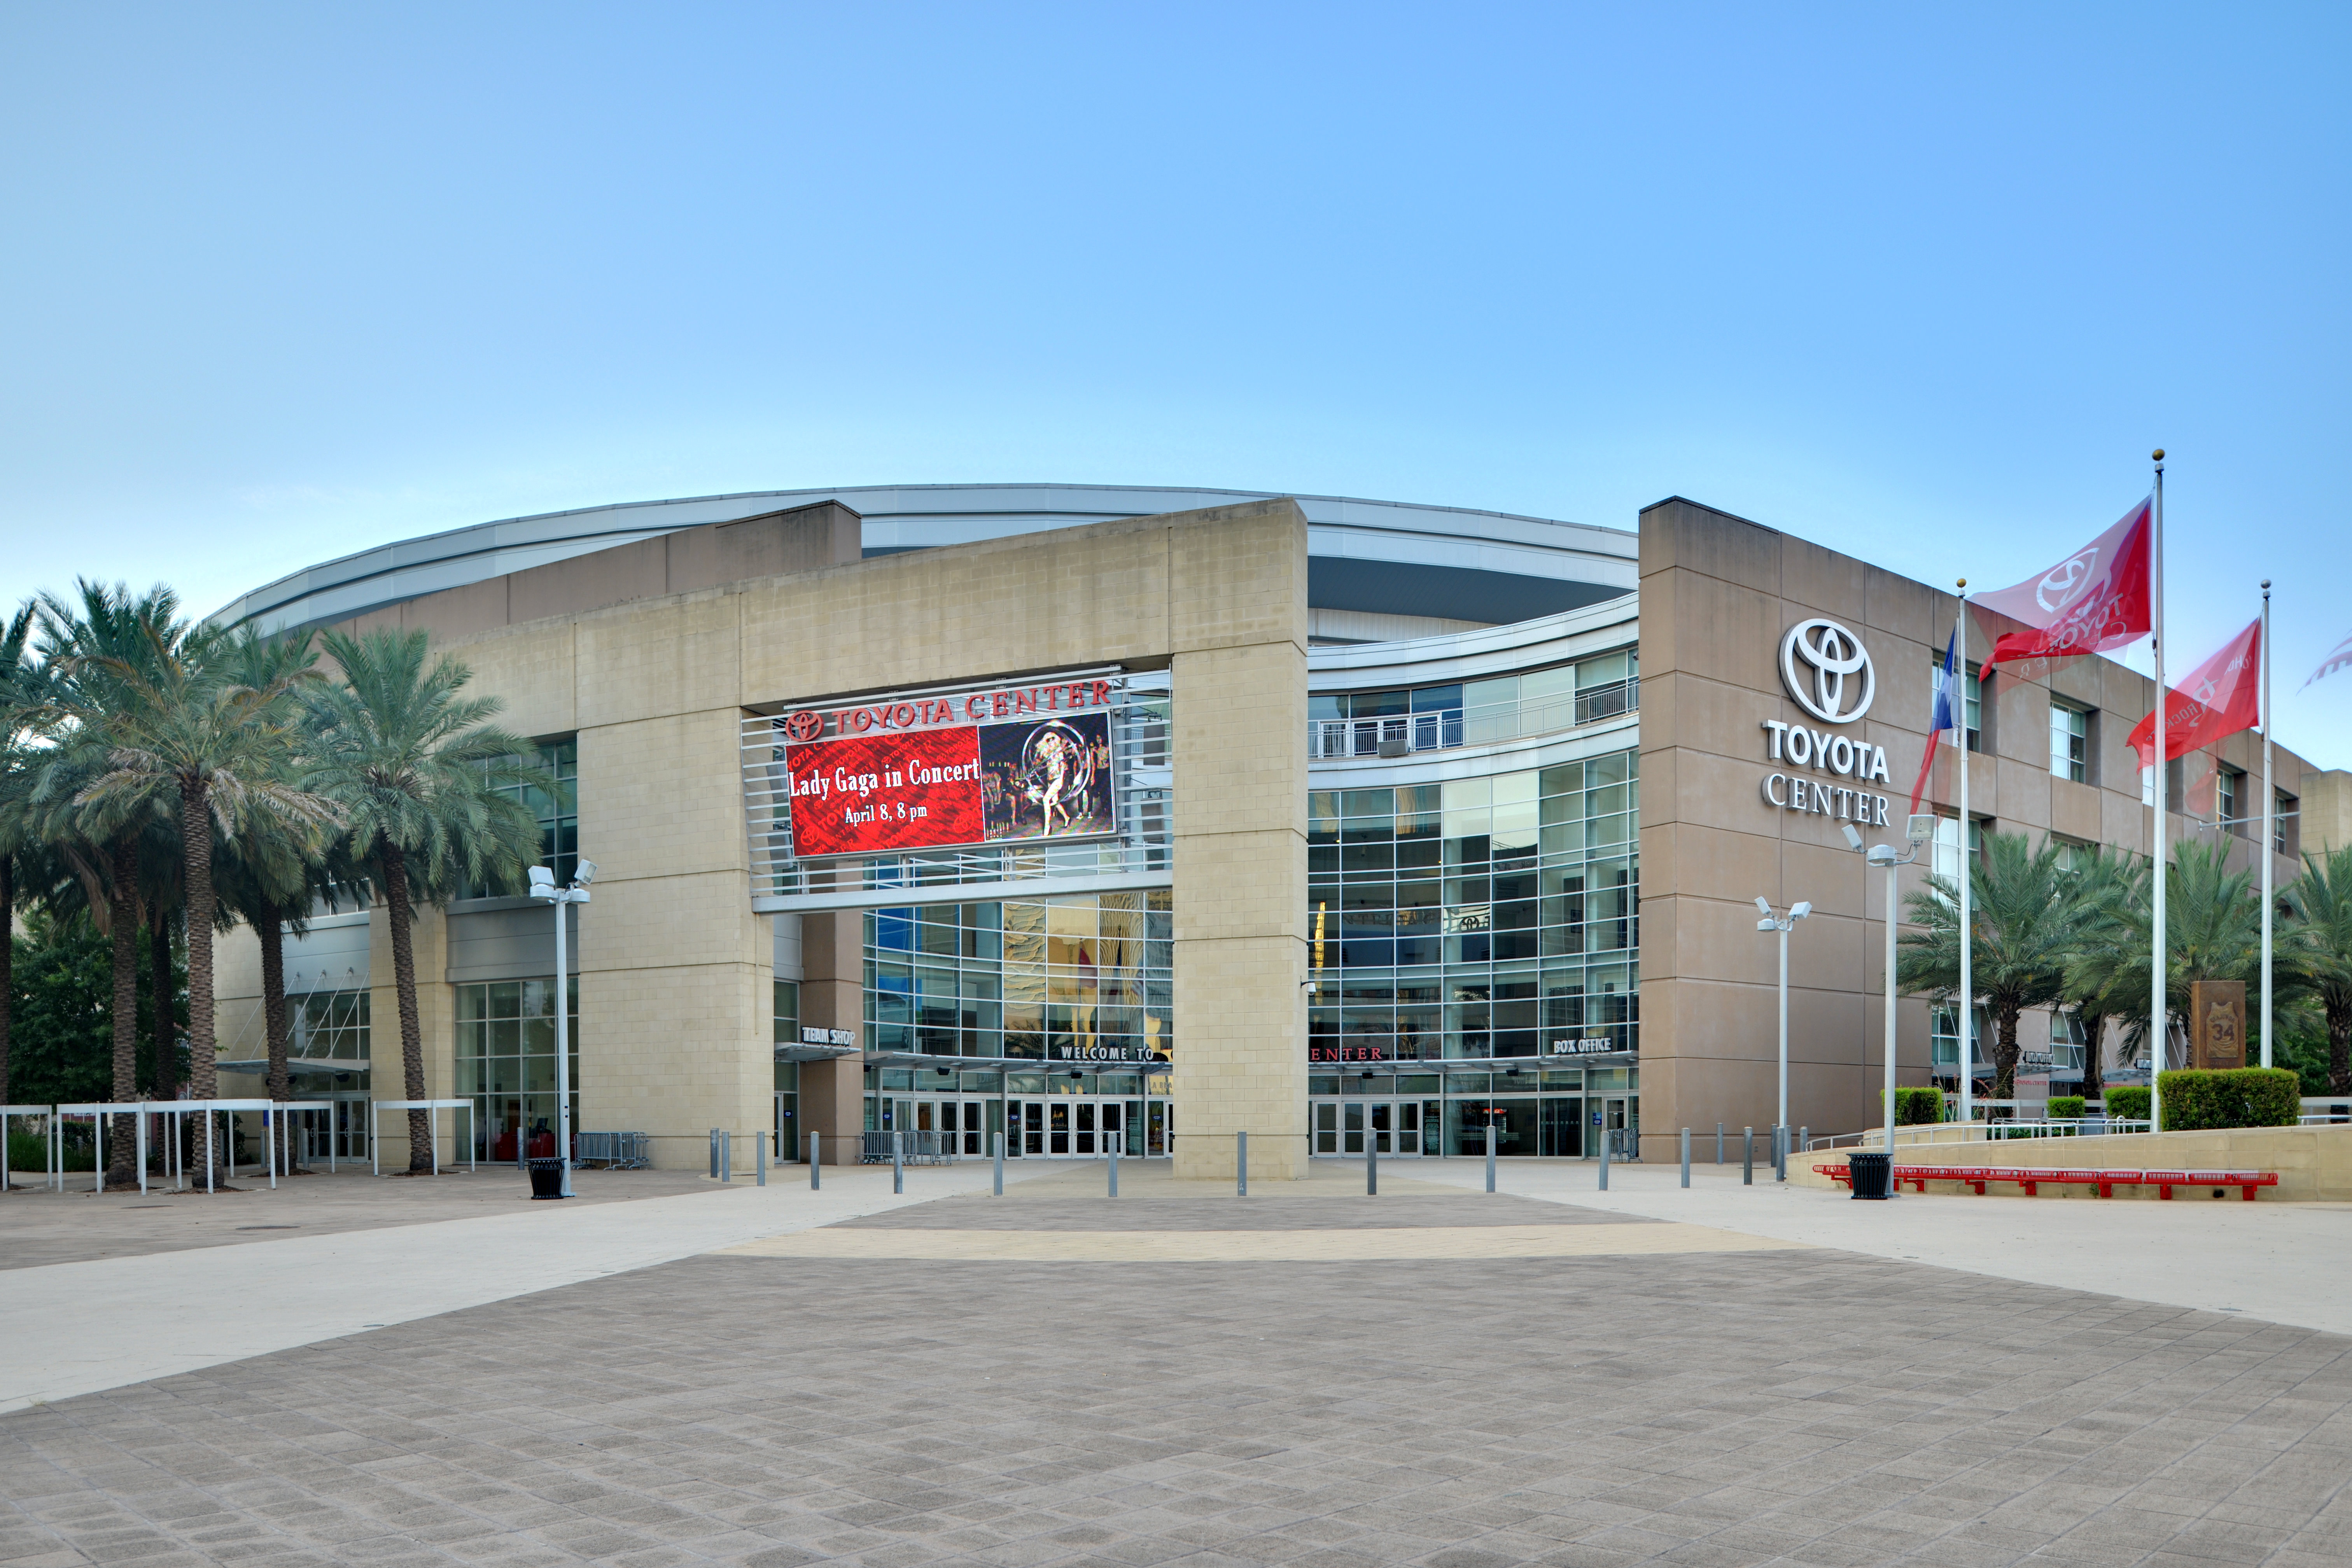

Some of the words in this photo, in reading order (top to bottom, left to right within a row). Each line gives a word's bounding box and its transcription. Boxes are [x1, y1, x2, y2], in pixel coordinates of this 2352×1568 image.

[832, 699, 954, 733] TOYOTA
[964, 680, 1111, 719] CENTER
[1762, 719, 1890, 784] TOYOTA
[789, 769, 830, 801] Lady
[835, 766, 879, 797] Gaga
[885, 764, 903, 788] in
[908, 757, 980, 785] Concert
[1762, 773, 1890, 827] CENTER
[845, 805, 875, 827] April
[880, 803, 892, 822] 8,
[897, 802, 906, 819] 8
[909, 806, 928, 822] pm
[802, 1027, 829, 1043] TEAM
[830, 1029, 856, 1045] SHOP
[2212, 1024, 2235, 1041] 34
[1060, 1046, 1127, 1060] WELCOME
[1136, 1048, 1154, 1060] TO
[1310, 1047, 1382, 1060] ENTER
[1554, 1040, 1577, 1054] BOX
[1578, 1037, 1611, 1052] OFFICE
[2027, 1052, 2038, 1064] BOX
[2038, 1052, 2056, 1063] OFFICE
